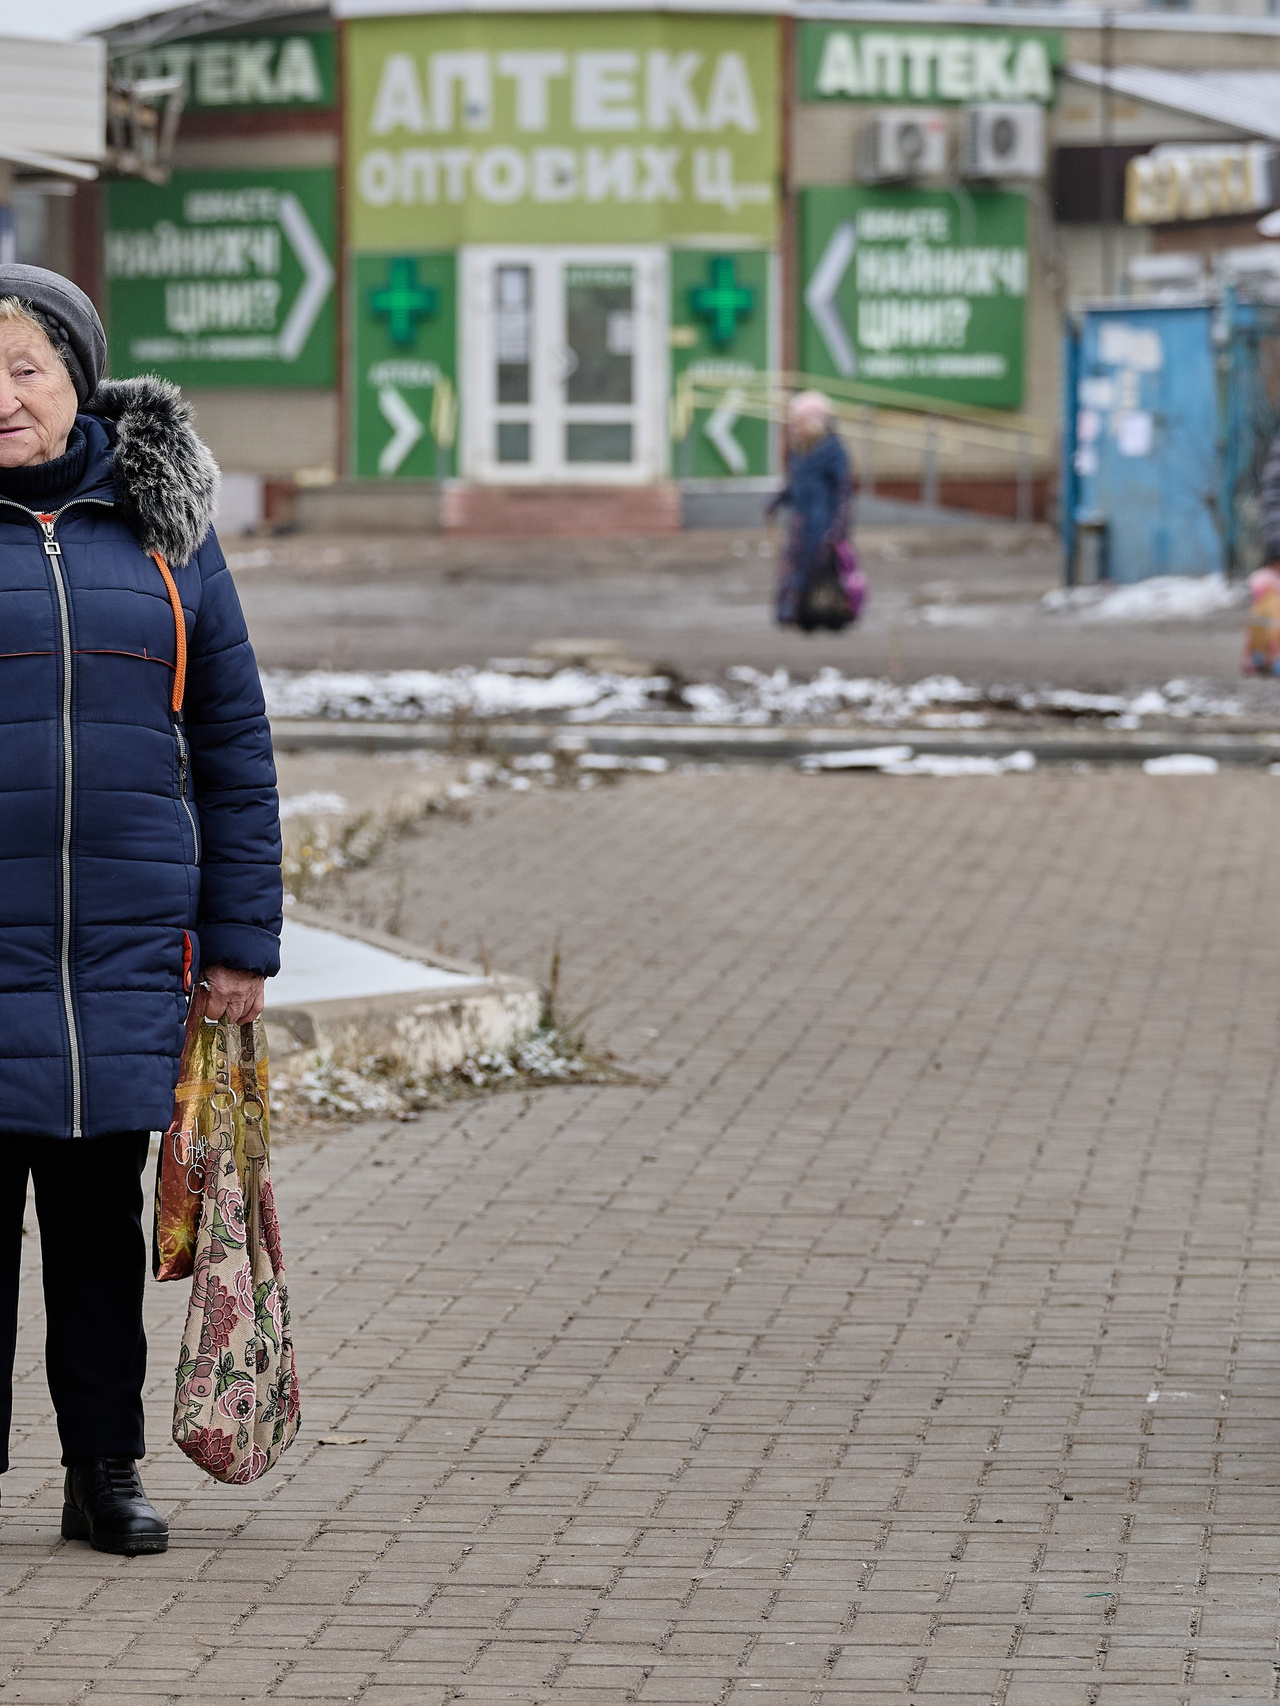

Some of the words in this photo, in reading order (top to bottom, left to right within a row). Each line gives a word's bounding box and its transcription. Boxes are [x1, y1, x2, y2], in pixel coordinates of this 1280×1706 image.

[370, 49, 760, 134] АПТЕКА
[817, 32, 1053, 99] АПТЕКА
[358, 145, 682, 206] ОПТОВИХ
